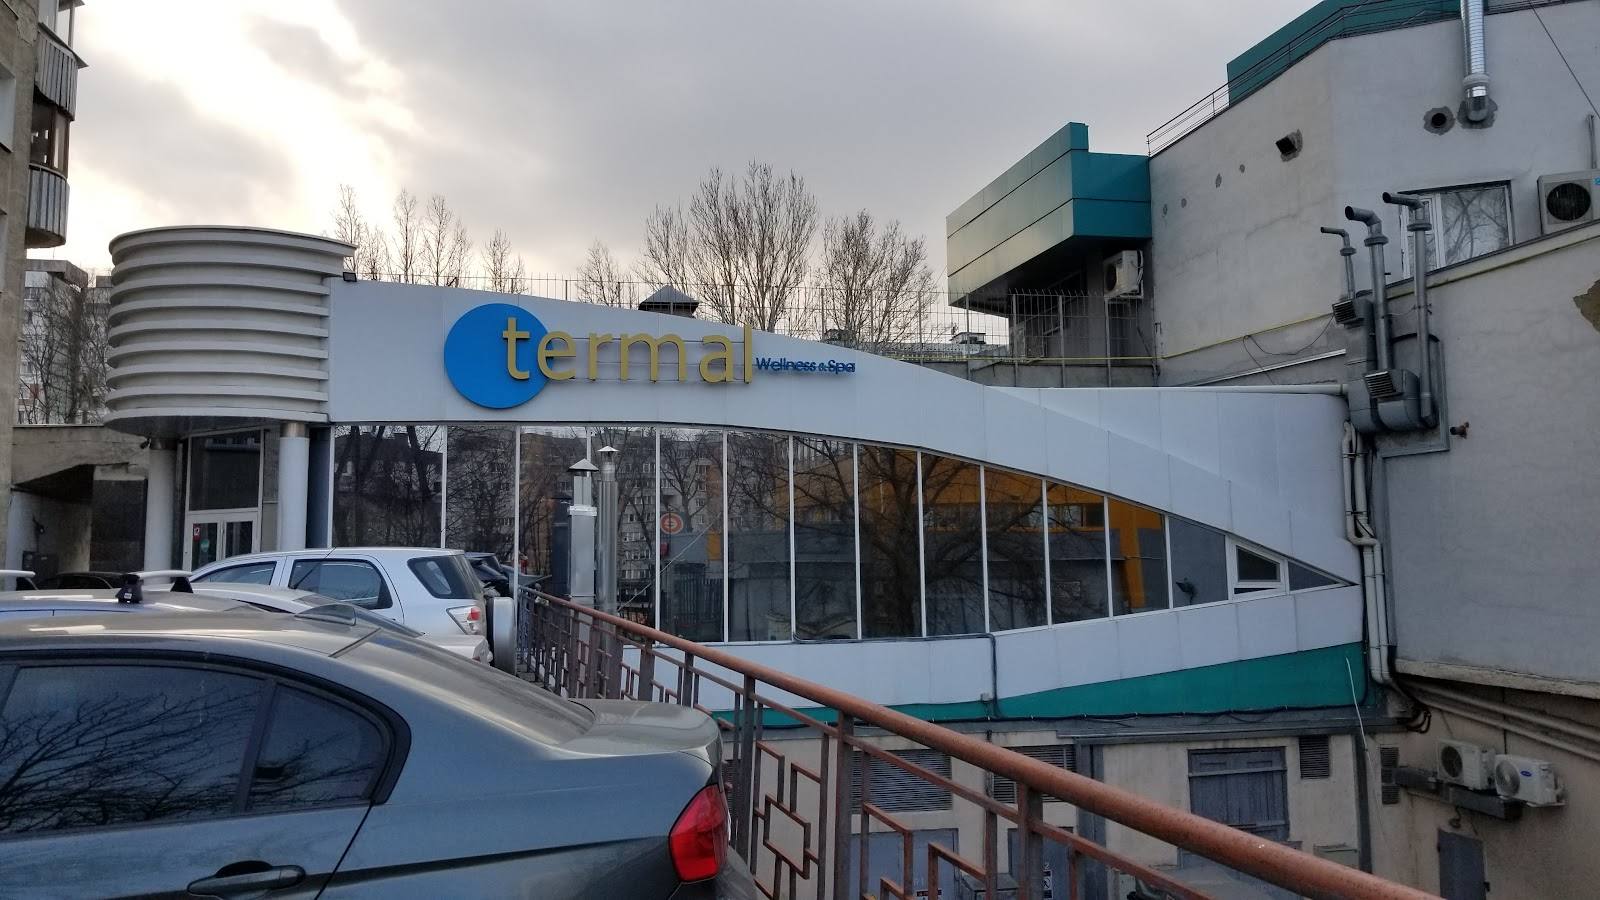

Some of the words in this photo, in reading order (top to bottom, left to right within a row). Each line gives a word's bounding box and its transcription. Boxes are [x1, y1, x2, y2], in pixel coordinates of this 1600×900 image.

[502, 317, 753, 384] termal
[756, 357, 817, 372] Wellness
[828, 359, 856, 375] Spa
